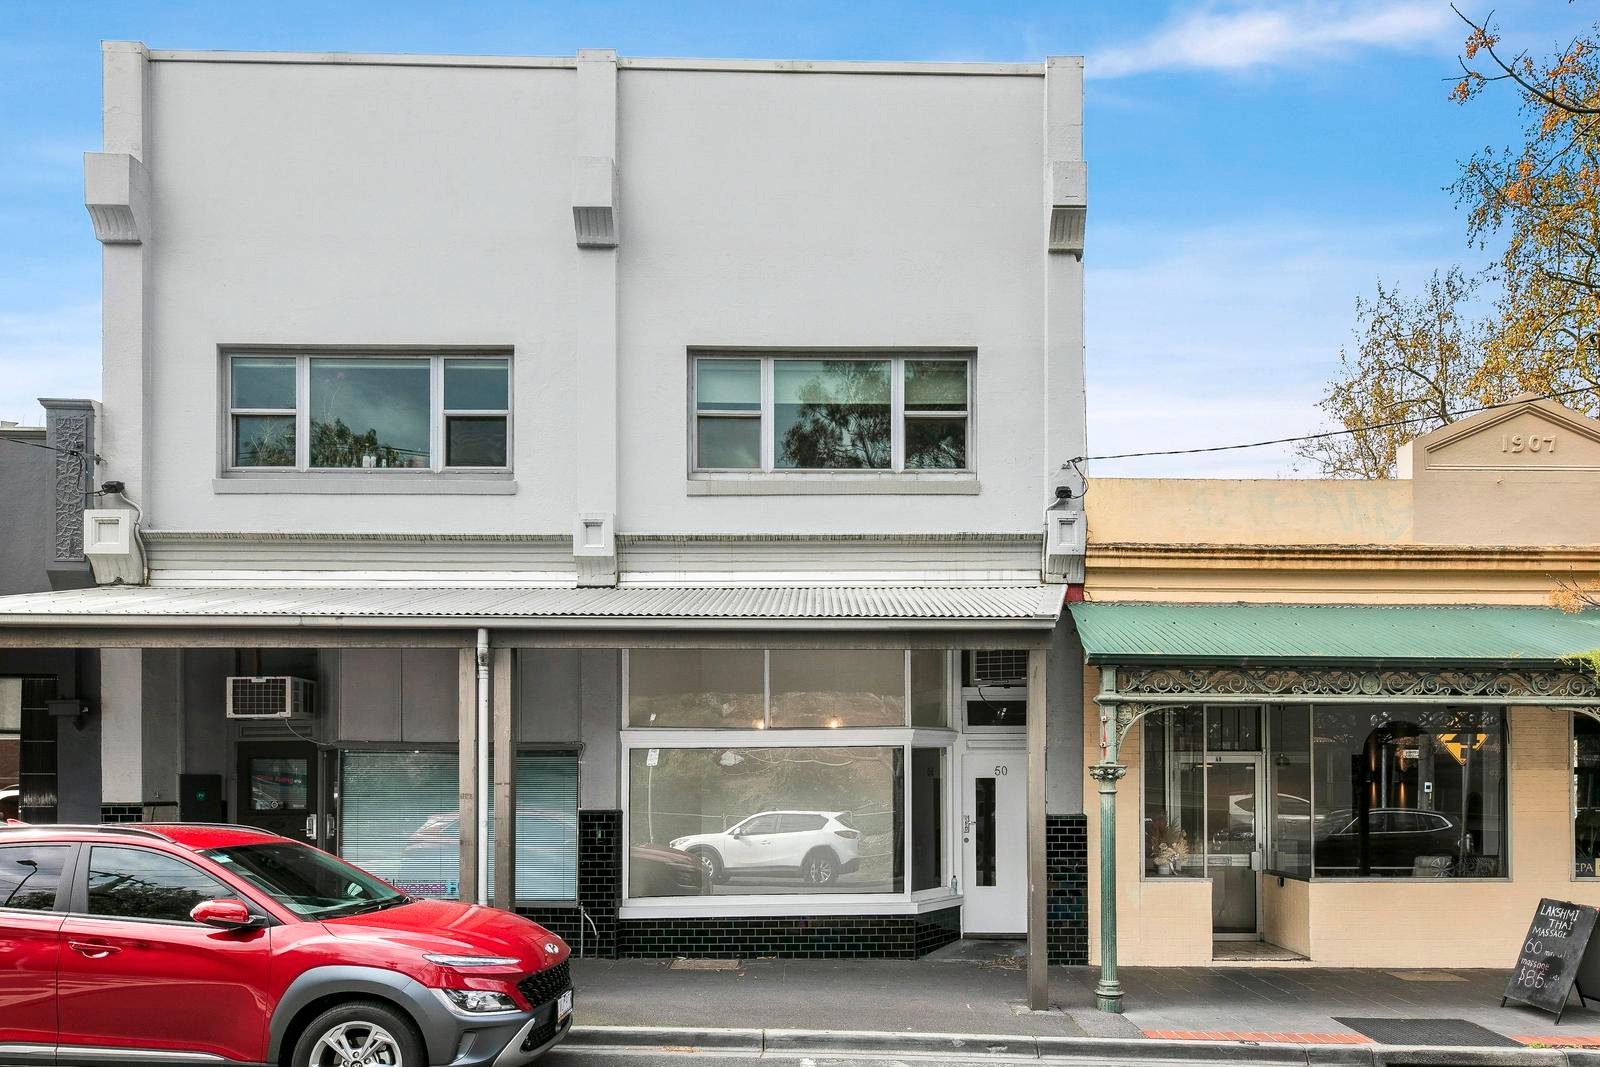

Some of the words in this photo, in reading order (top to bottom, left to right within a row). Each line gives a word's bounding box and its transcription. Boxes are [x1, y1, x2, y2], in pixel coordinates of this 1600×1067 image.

[1501, 434, 1556, 453] 1907
[994, 765, 1008, 776] 50
[1541, 905, 1579, 921] LAKSHMI
[1531, 925, 1568, 939] MASSAGE
[1549, 918, 1574, 931] THAI
[1525, 938, 1543, 955] 60
[1517, 965, 1545, 989] $85
